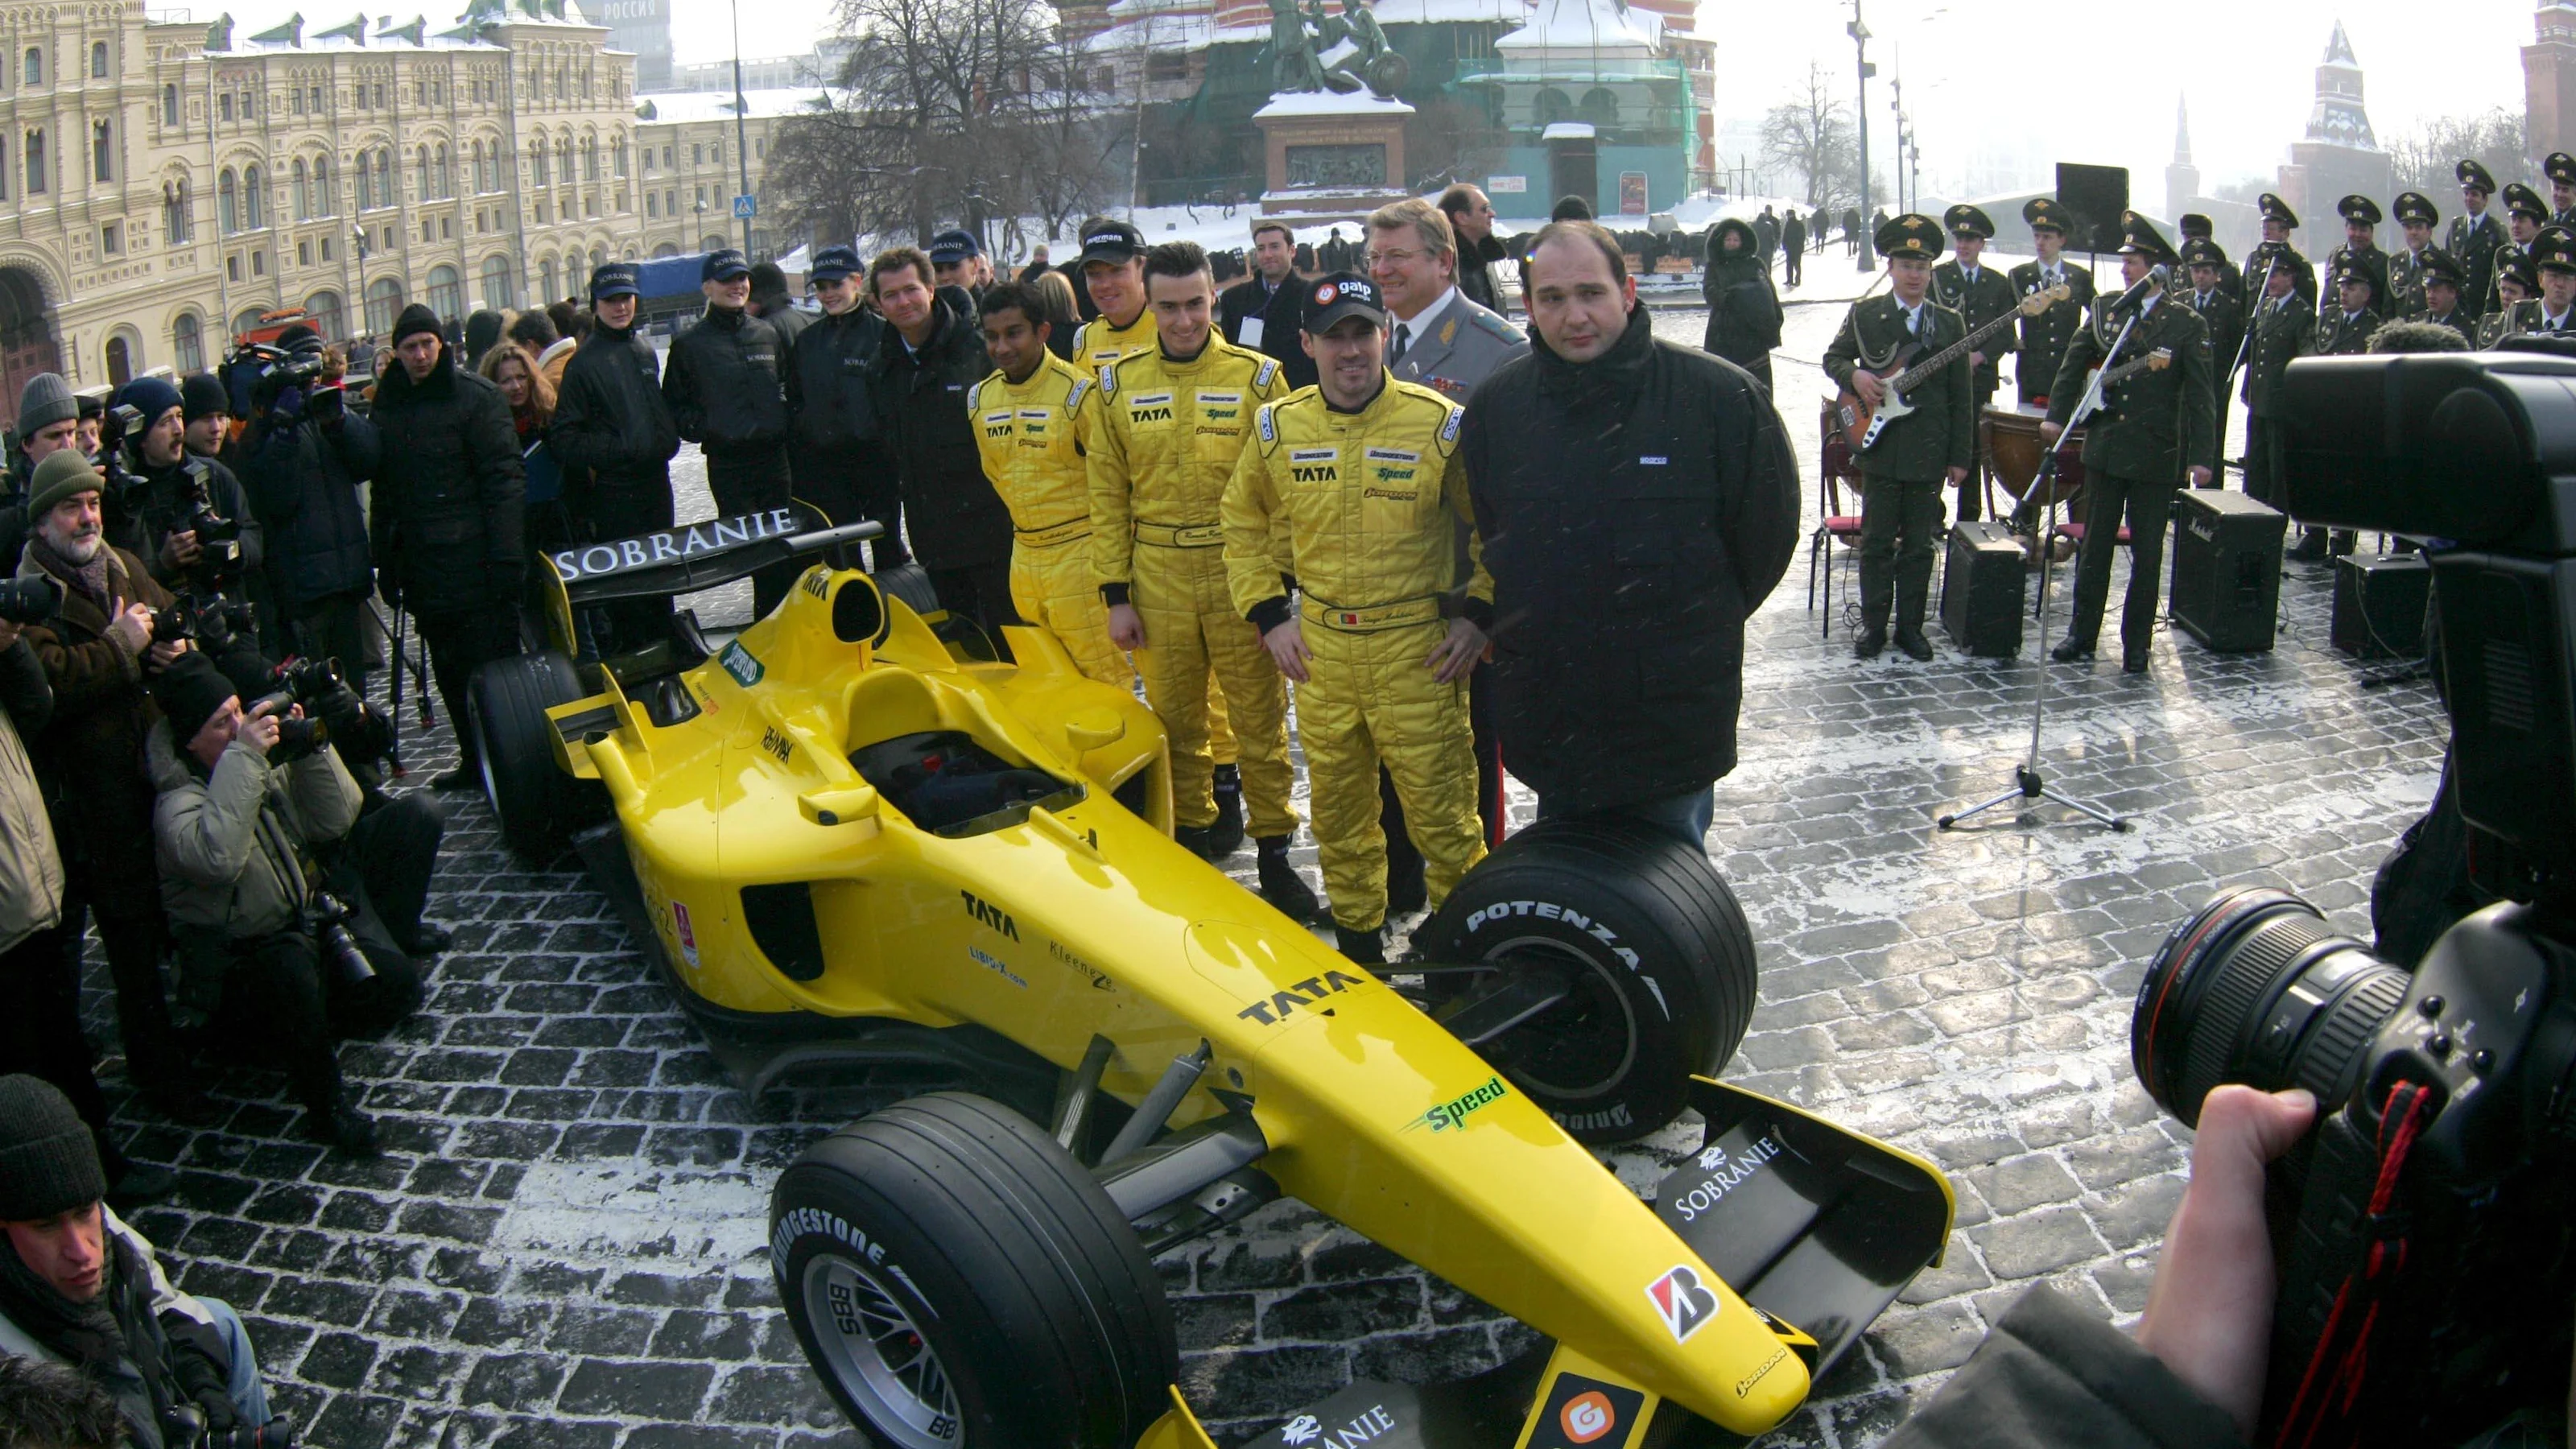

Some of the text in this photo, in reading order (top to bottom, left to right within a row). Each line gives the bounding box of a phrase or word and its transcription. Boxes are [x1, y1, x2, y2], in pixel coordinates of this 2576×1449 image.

[605, 0, 655, 19] РОССИЯ
[1339, 281, 1371, 296] galp
[986, 425, 1012, 438] TATA
[1131, 407, 1171, 423] TATA
[1292, 466, 1337, 482] TATA
[1377, 467, 1415, 482] Speed
[555, 507, 796, 581] SOBRANIE
[961, 889, 1020, 943] TATA
[1466, 900, 1641, 972] POTENZA
[2176, 948, 2201, 984] CANON
[1236, 970, 1366, 1026] TATA
[1424, 1075, 1509, 1133] Speed
[1675, 1137, 1780, 1220] SOBRANIE
[830, 1282, 862, 1335] BBS
[1736, 1348, 1787, 1399] JORDAN
